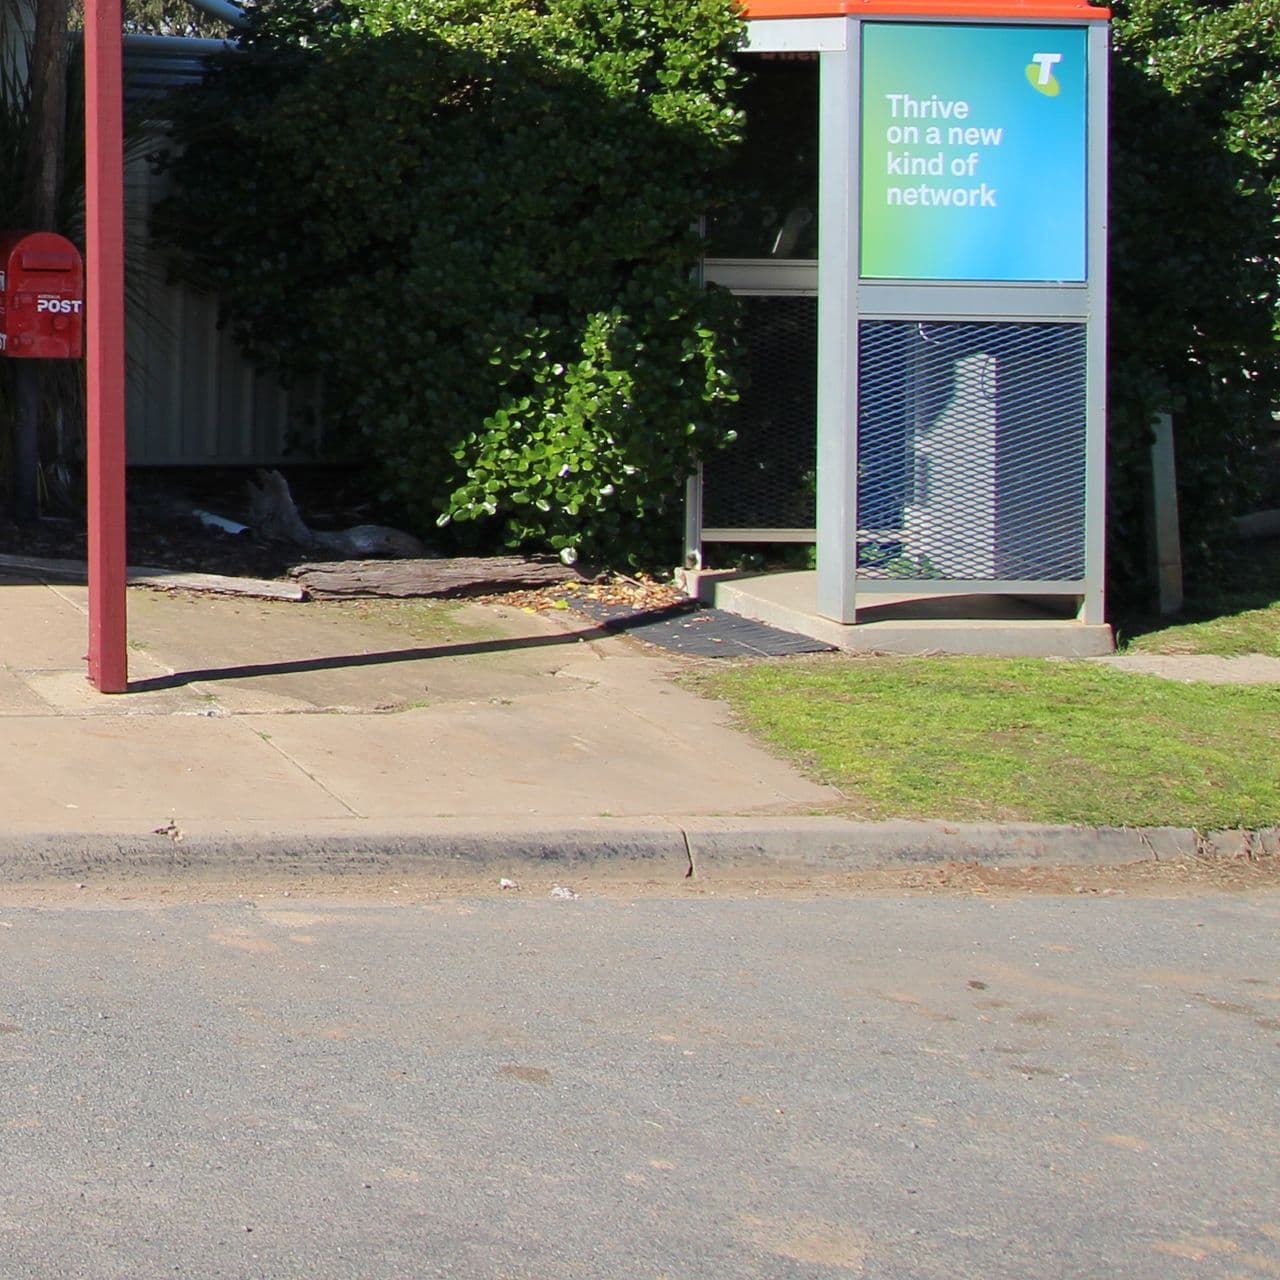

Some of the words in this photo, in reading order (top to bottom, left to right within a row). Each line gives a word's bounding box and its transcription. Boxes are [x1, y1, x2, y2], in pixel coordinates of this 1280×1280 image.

[885, 93, 969, 119] Thrive
[886, 126, 921, 145] on
[926, 126, 941, 145] a
[948, 126, 1003, 145] new
[887, 153, 944, 176] kind
[951, 152, 979, 176] of
[886, 183, 997, 207] network
[37, 300, 82, 313] POST
